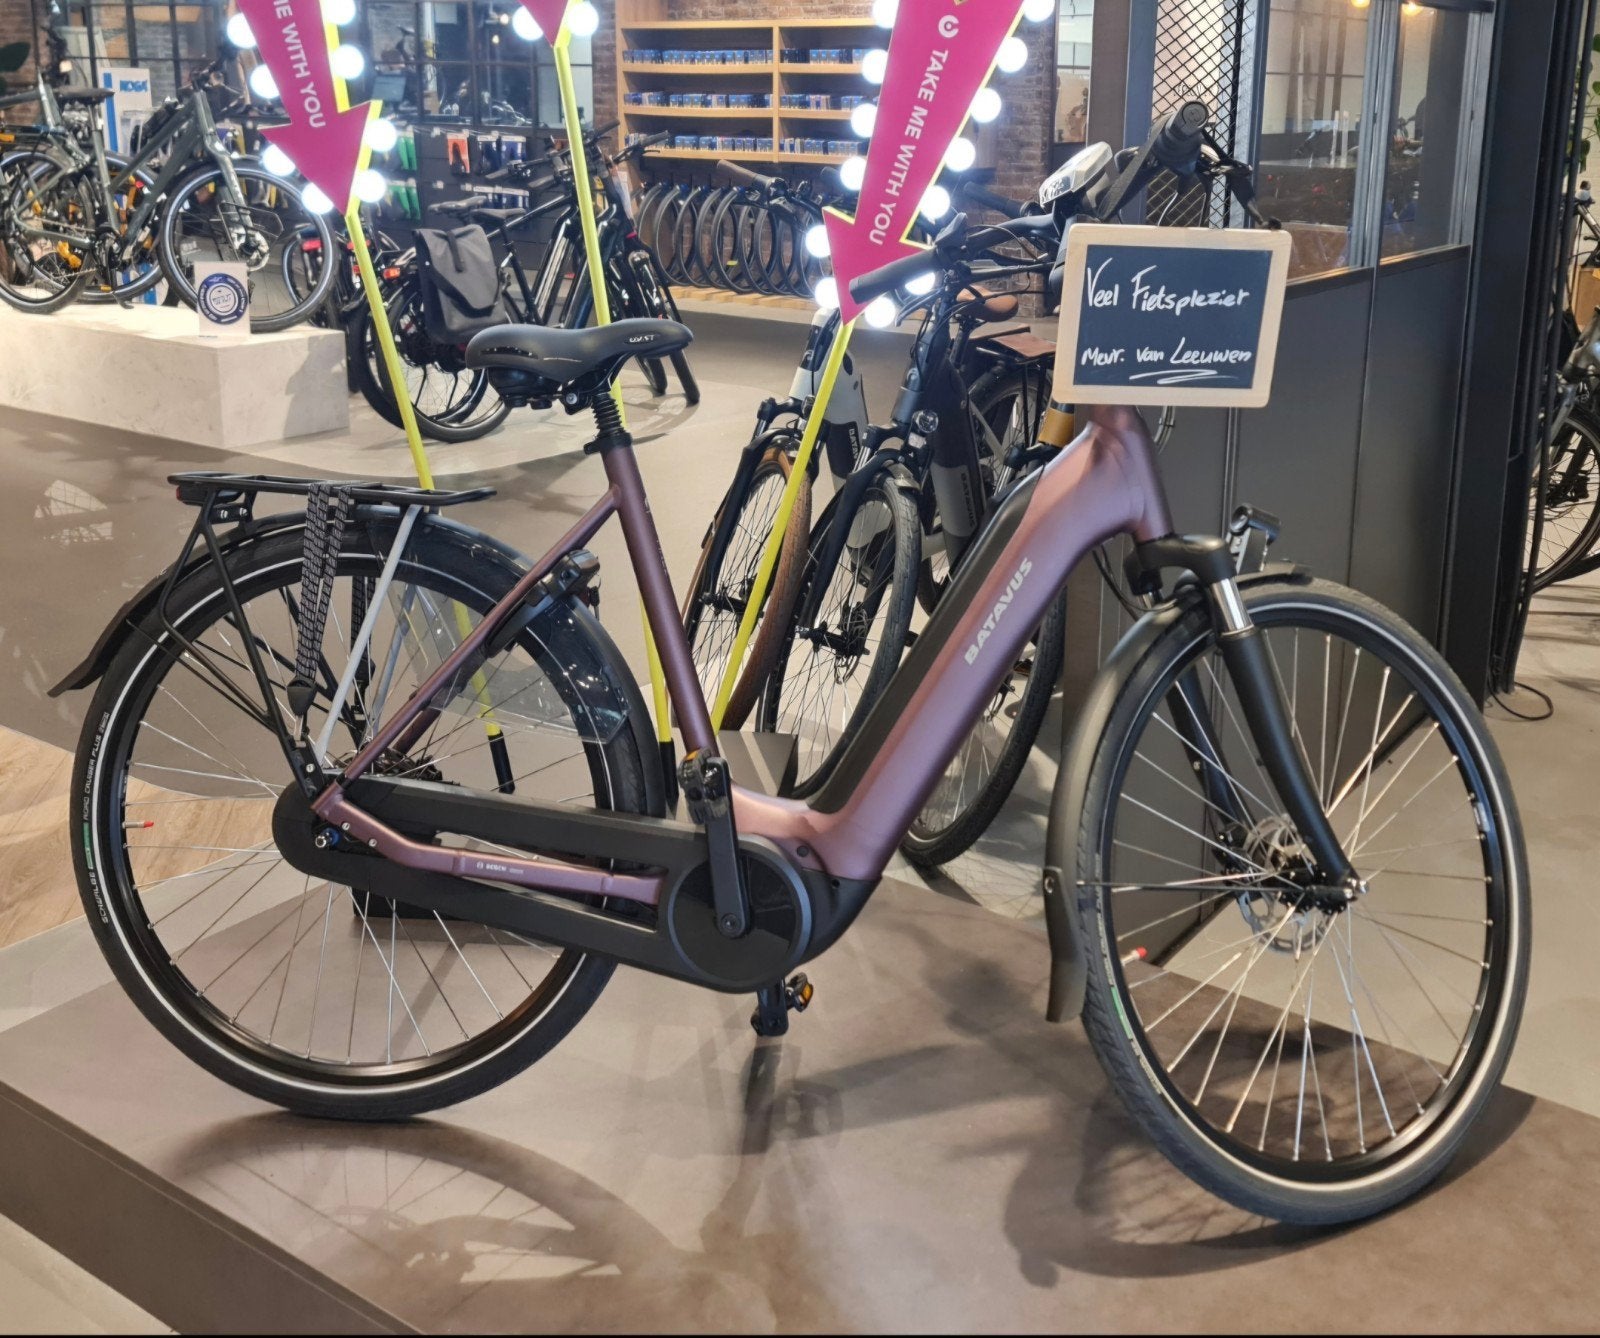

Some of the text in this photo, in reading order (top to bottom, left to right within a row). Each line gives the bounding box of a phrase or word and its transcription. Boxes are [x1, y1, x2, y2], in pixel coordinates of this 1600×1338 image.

[282, 22, 311, 78] WITH
[300, 81, 326, 128] YOU
[868, 50, 949, 246] TAKE ME WITH YOU
[1087, 257, 1250, 316] Veel Fietsplezier
[1169, 336, 1252, 365] Leeuwen
[964, 557, 1033, 666] BATAVUS
